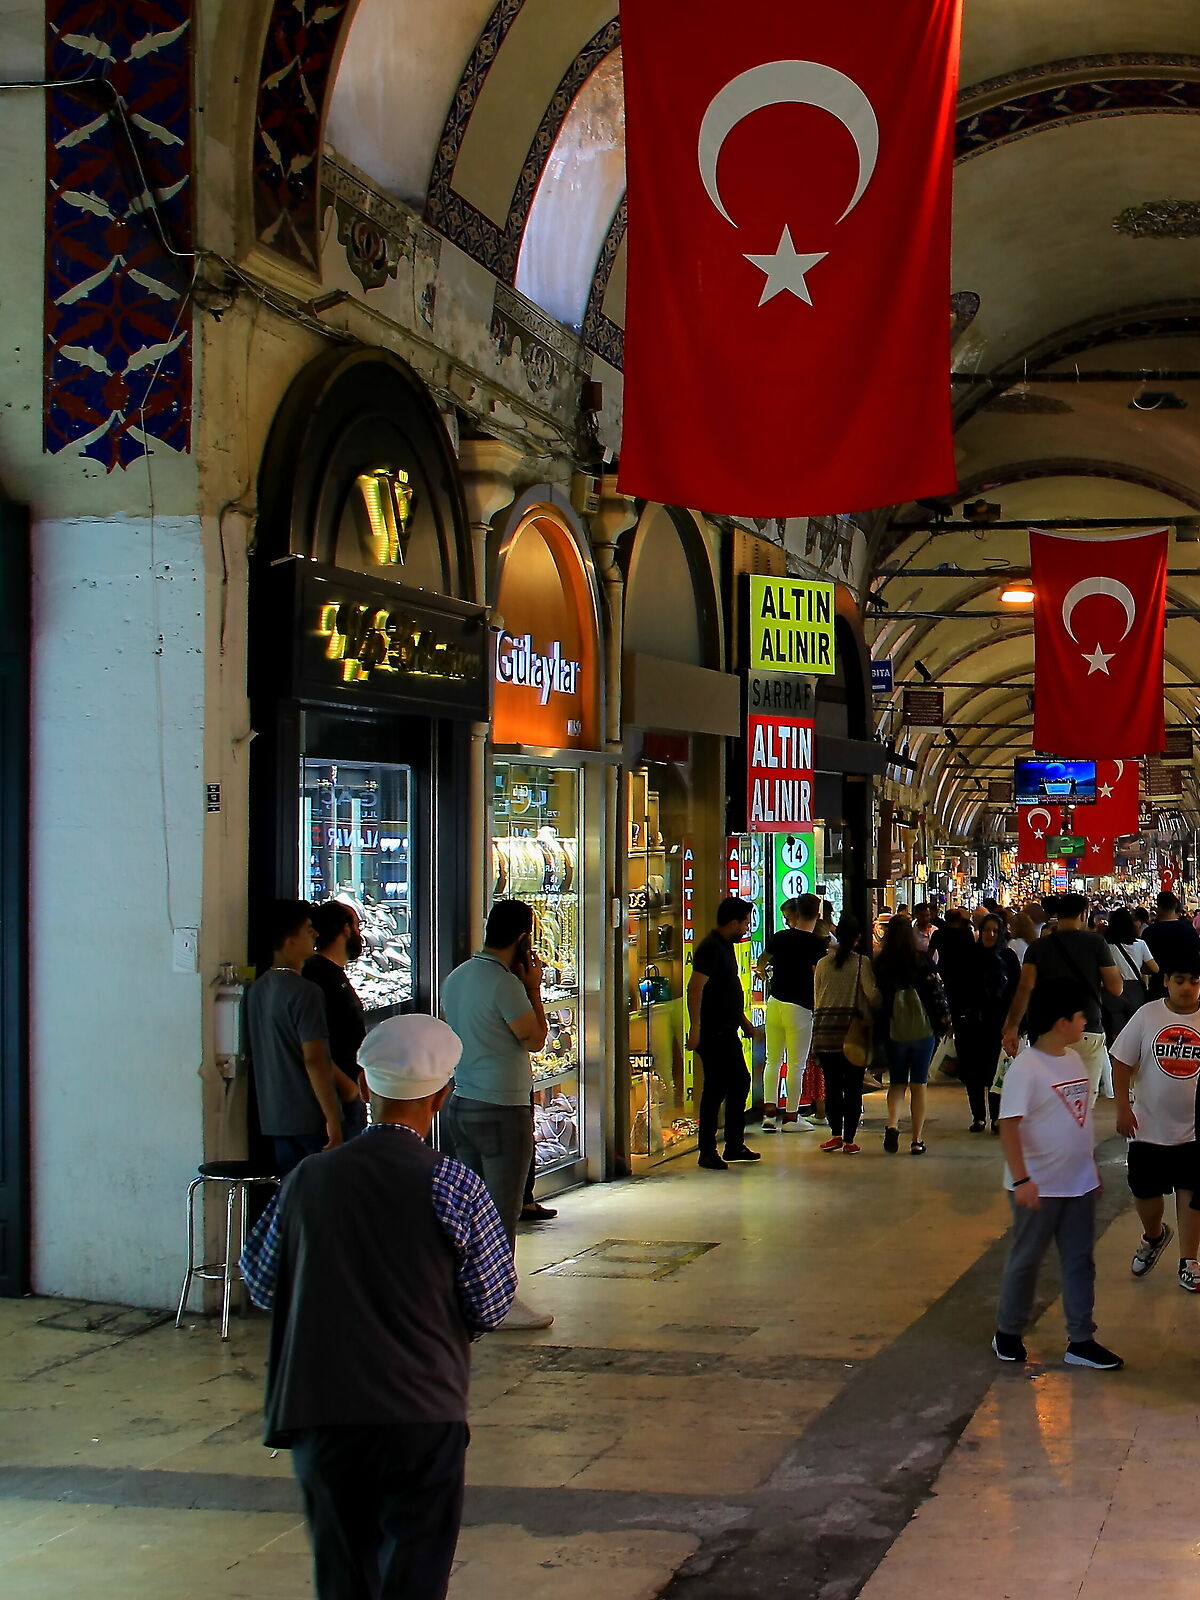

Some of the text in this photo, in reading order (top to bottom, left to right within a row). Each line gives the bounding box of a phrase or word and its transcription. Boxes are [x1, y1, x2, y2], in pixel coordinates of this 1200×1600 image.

[760, 585, 831, 624] ALTIN
[760, 628, 831, 666] ALINIR
[495, 629, 582, 706] Gülaylar
[752, 678, 812, 711] SARRAF
[751, 724, 812, 770] ALTIN
[751, 779, 812, 823] ALINIR
[788, 875, 804, 897] 18
